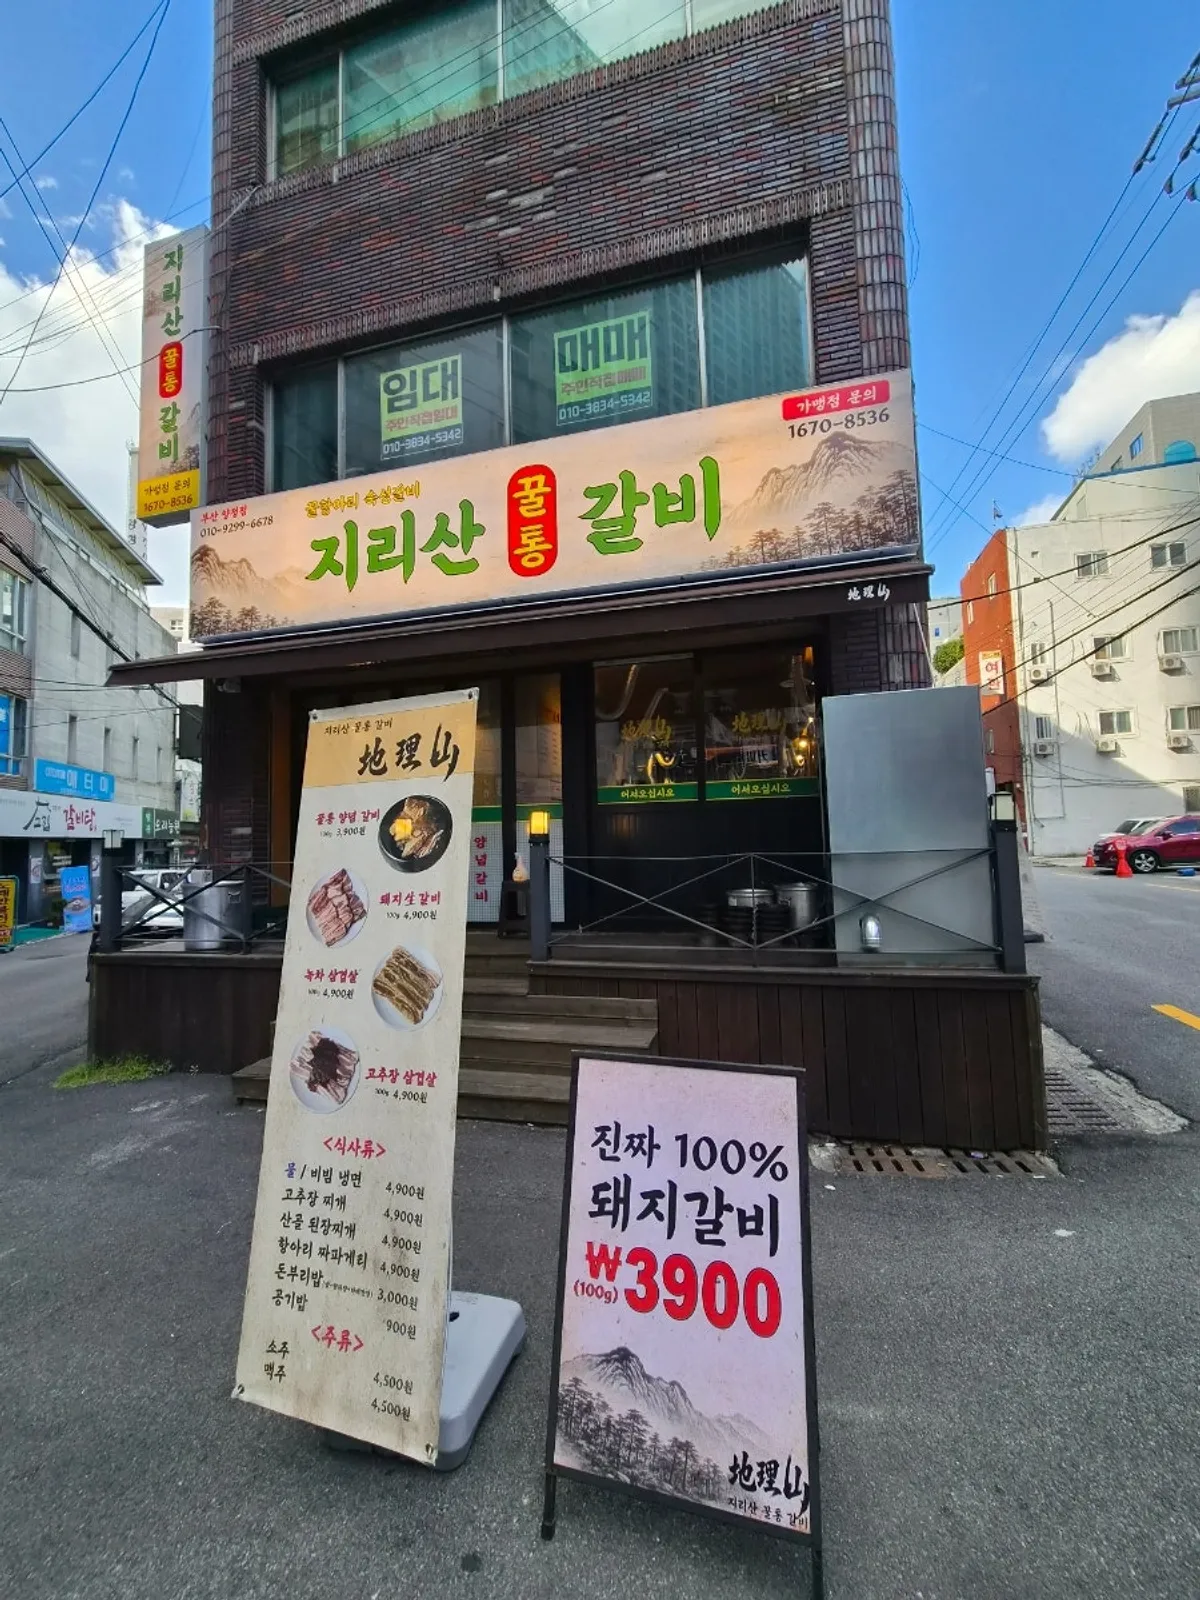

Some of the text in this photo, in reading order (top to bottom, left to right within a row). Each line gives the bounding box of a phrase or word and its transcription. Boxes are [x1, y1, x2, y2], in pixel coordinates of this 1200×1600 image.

[158, 244, 183, 462] 지리산 꿀통 갈비
[557, 315, 648, 373] 매매
[383, 359, 459, 414] 임대
[559, 391, 651, 420] 010-3834-5342
[796, 385, 876, 414] 가맹점 문의
[788, 407, 890, 439] 1670-8536
[383, 428, 461, 454] 010-3834-5342
[144, 494, 193, 512] 1670-8536
[200, 515, 274, 538] 010-9299-6678
[201, 510, 219, 524] 부산
[305, 455, 722, 593] 지리산 꿀통 갈비
[848, 582, 891, 602] 地理山
[324, 723, 350, 735] 지리산
[375, 717, 393, 731] 갈비
[357, 723, 460, 782] 地理山
[339, 811, 357, 824] 양념
[361, 808, 380, 823] 갈비
[336, 826, 366, 838] 3,900원
[473, 835, 488, 902] 양념갈비
[403, 910, 437, 920] 4,900원
[304, 968, 359, 984] 녹차 삼겹살
[323, 988, 355, 1000] 4,900원
[365, 1067, 438, 1087] 고추장 삼겹살
[393, 1089, 428, 1104] 4,900원
[590, 1120, 789, 1182] 진짜 100%
[284, 1162, 297, 1178] 물
[310, 1165, 333, 1184] 비빔
[339, 1170, 362, 1188] 냉면
[282, 1187, 347, 1212] 고추장 찌개
[385, 1182, 425, 1200] 4,900원
[280, 1211, 355, 1240] 산골 된장찌개
[383, 1208, 423, 1228] 4,900원
[588, 1173, 780, 1258] 돼지갈비
[278, 1236, 313, 1259] 항아리
[381, 1235, 422, 1255] 4,900원
[275, 1262, 323, 1288] 돈부리밥
[380, 1261, 420, 1283] 4,900원
[272, 1289, 308, 1312] 공기밥
[377, 1288, 419, 1312] 3,000원
[573, 1279, 619, 1304] (100g)
[386, 1319, 416, 1340] 900원
[265, 1339, 290, 1359] 소주
[264, 1361, 287, 1383] 맥주
[373, 1372, 414, 1395] 4,500원
[371, 1397, 411, 1422] 4,500원
[728, 1450, 811, 1520] 地理山
[728, 1496, 808, 1531] 지리산 꿀통 갈비
